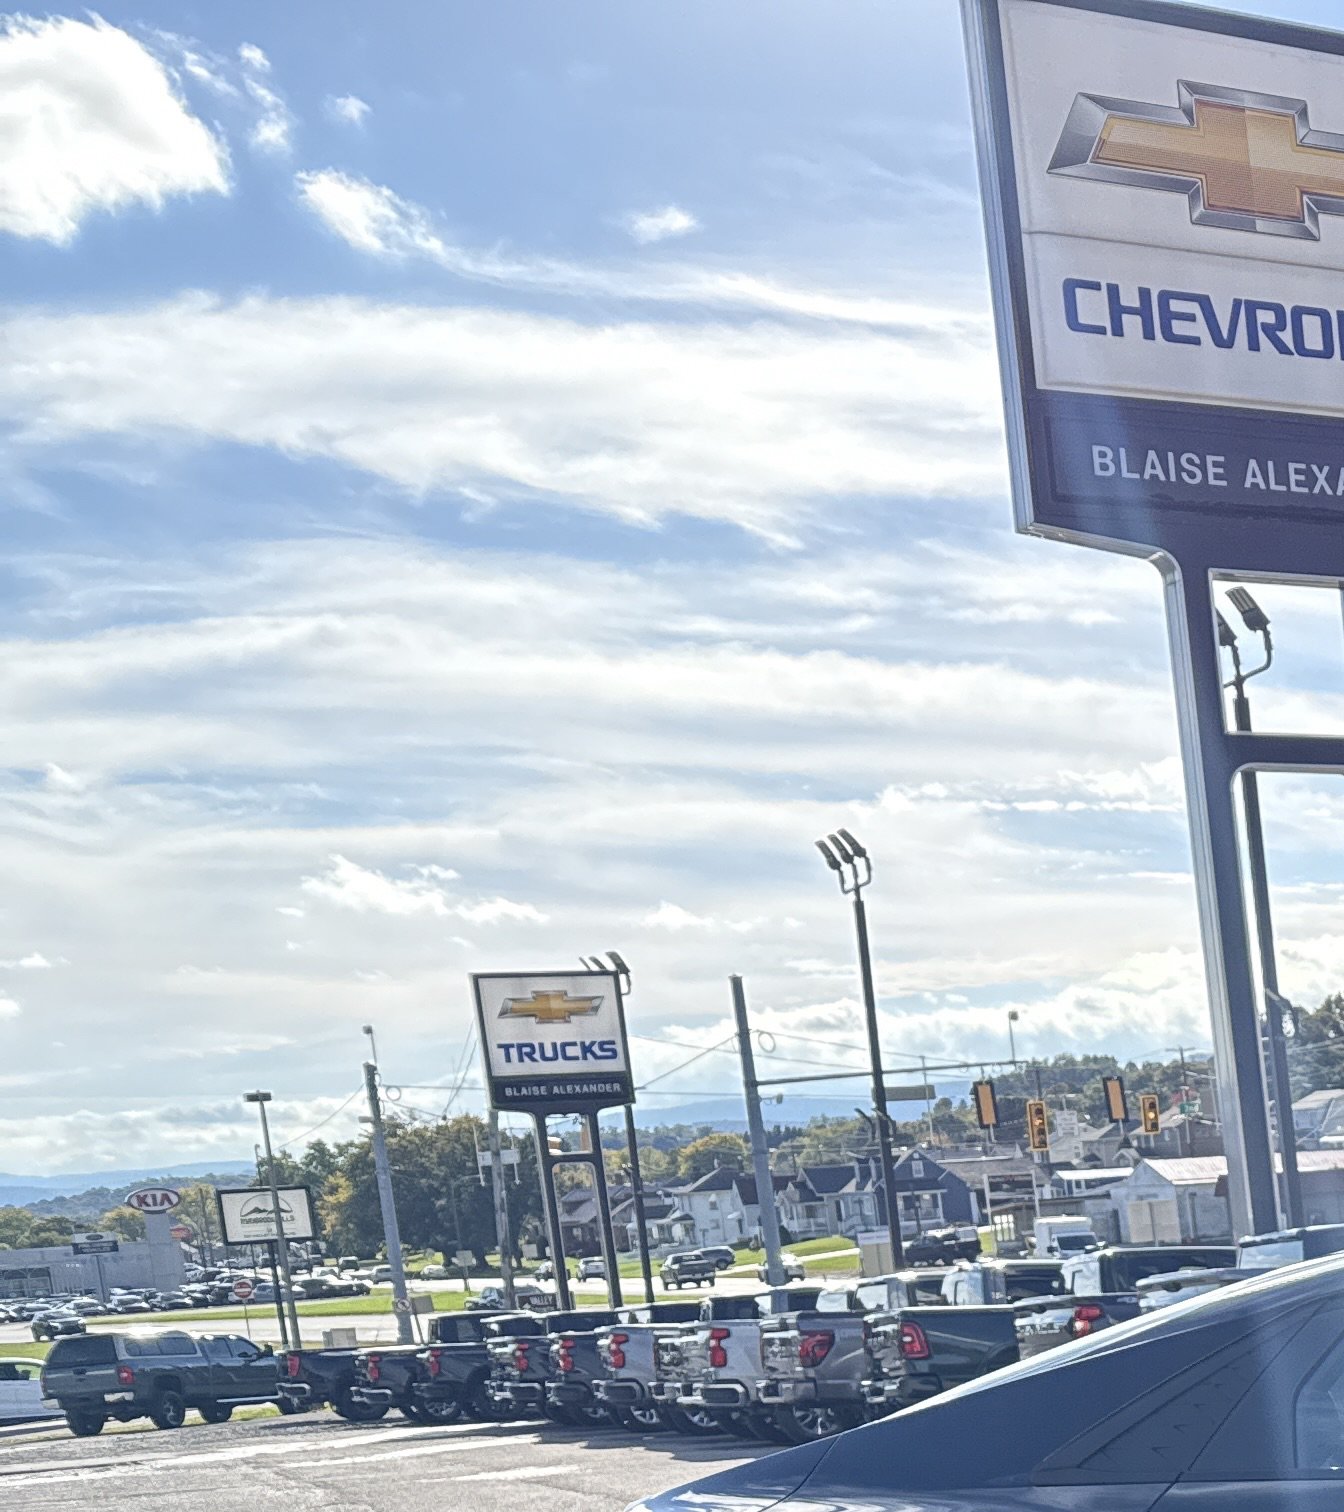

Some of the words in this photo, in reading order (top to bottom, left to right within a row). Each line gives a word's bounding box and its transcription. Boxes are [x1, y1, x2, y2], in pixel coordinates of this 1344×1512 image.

[1091, 445, 1228, 486] BLAISE
[497, 1040, 618, 1063] TRUCKS
[504, 1085, 548, 1097] BLAISE
[552, 1082, 621, 1095] ALEXANDER
[135, 1193, 174, 1208] KIA
